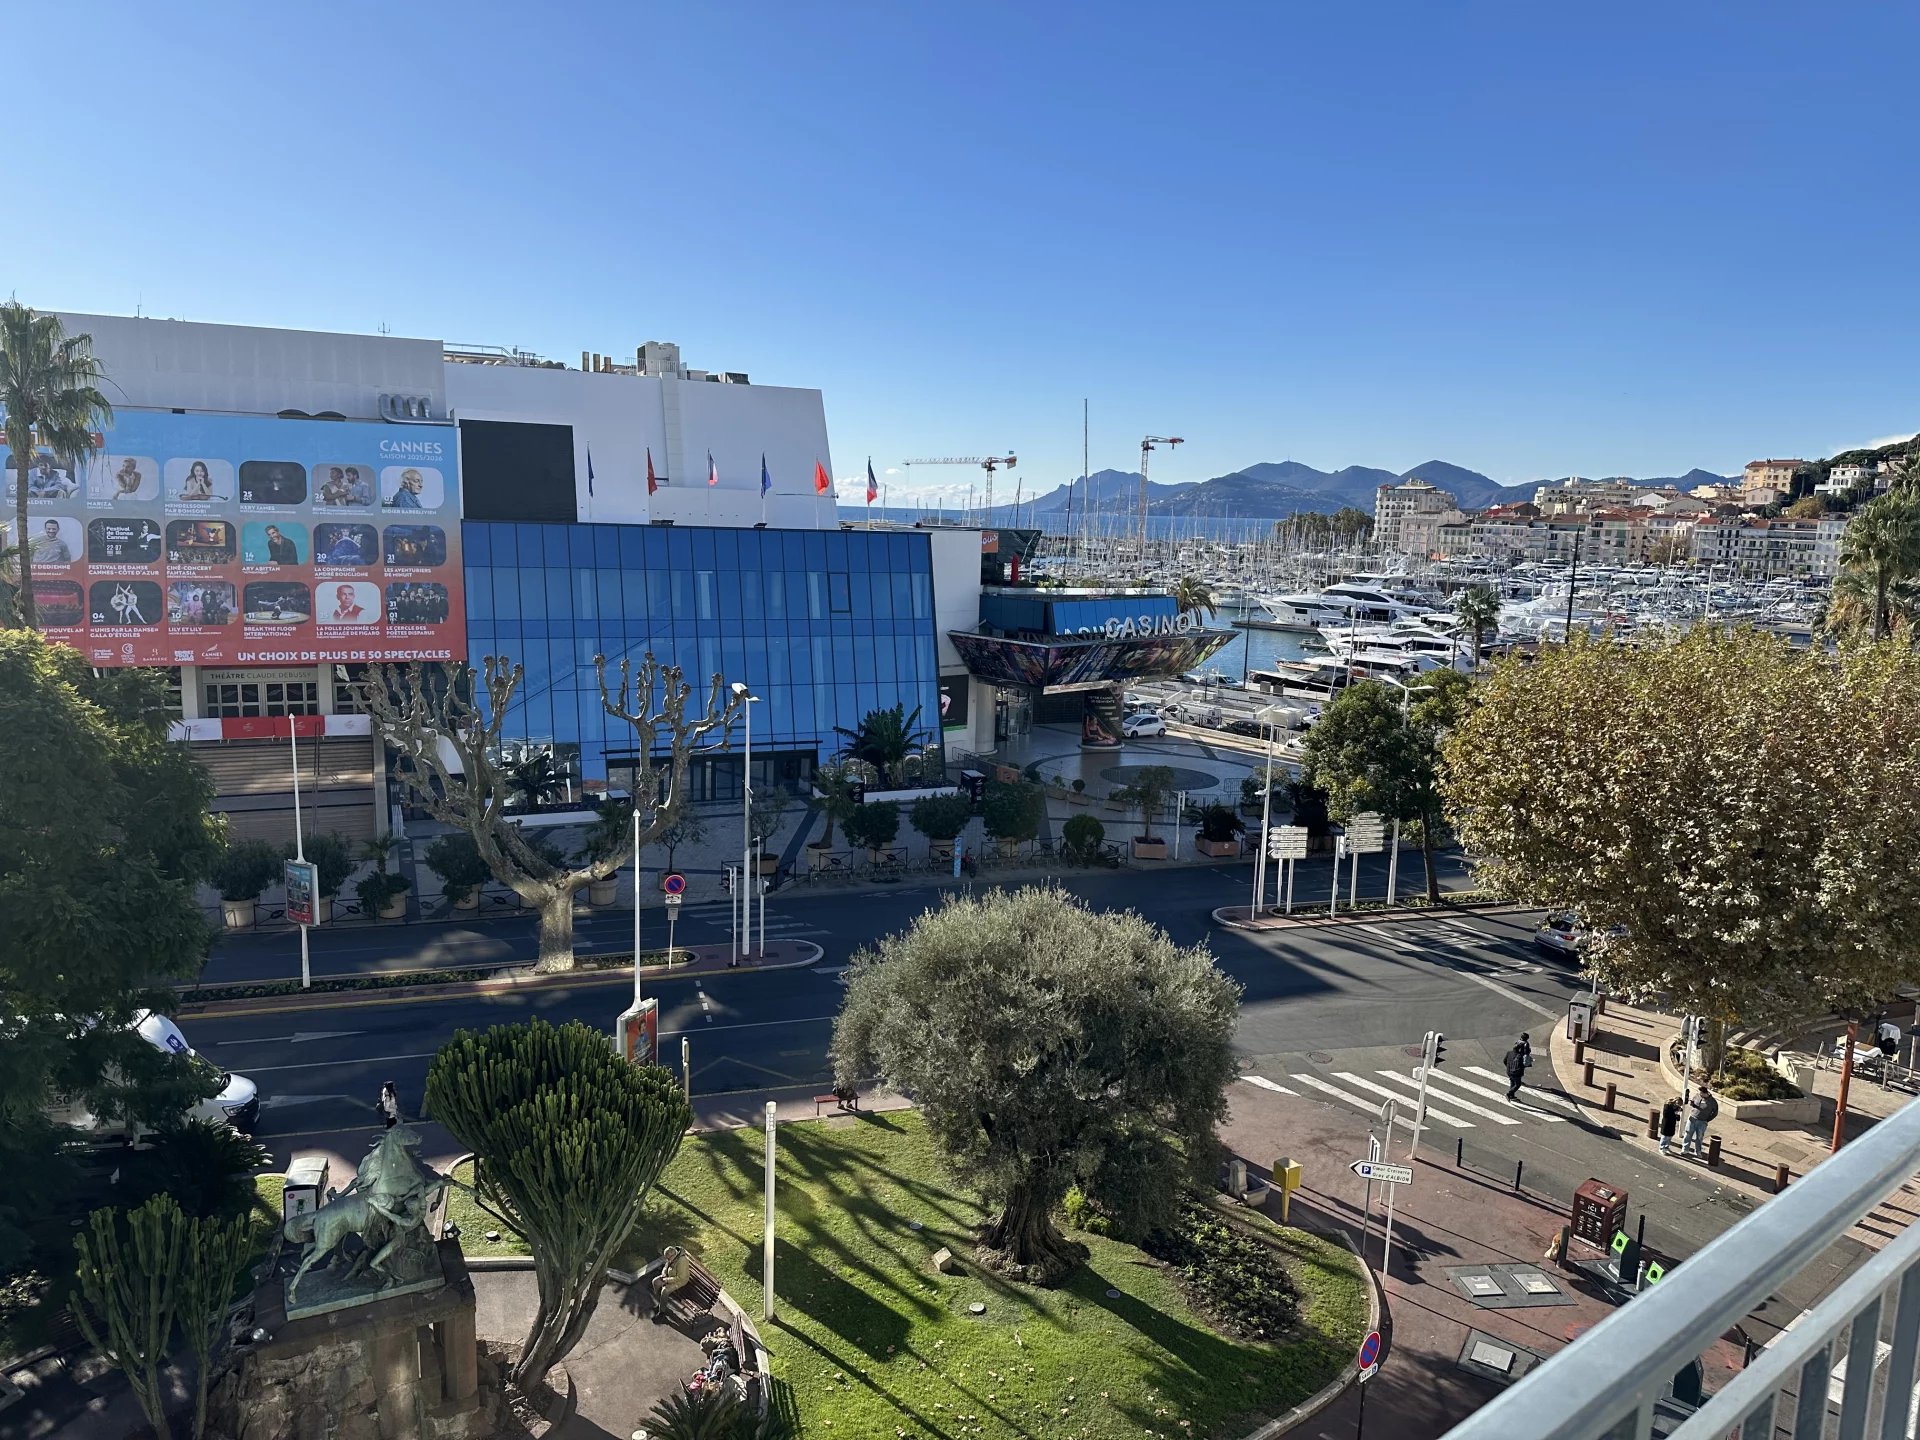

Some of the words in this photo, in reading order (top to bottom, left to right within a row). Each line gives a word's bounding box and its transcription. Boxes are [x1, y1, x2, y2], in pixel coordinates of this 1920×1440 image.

[379, 440, 443, 454] CANNES
[407, 454, 443, 462] 2025/2026
[245, 551, 254, 559] 14
[1104, 612, 1192, 639] CASINO
[238, 651, 256, 661] UN
[258, 651, 298, 661] CHOIX
[300, 651, 317, 660] DE
[319, 651, 348, 660] PLUS
[351, 651, 366, 660] DE
[367, 650, 382, 659] 50
[384, 649, 451, 660] SPECTACLES
[210, 671, 246, 680] THÉÂTRE
[246, 671, 278, 679] CLAUDE
[278, 671, 312, 679] DEBUSSY
